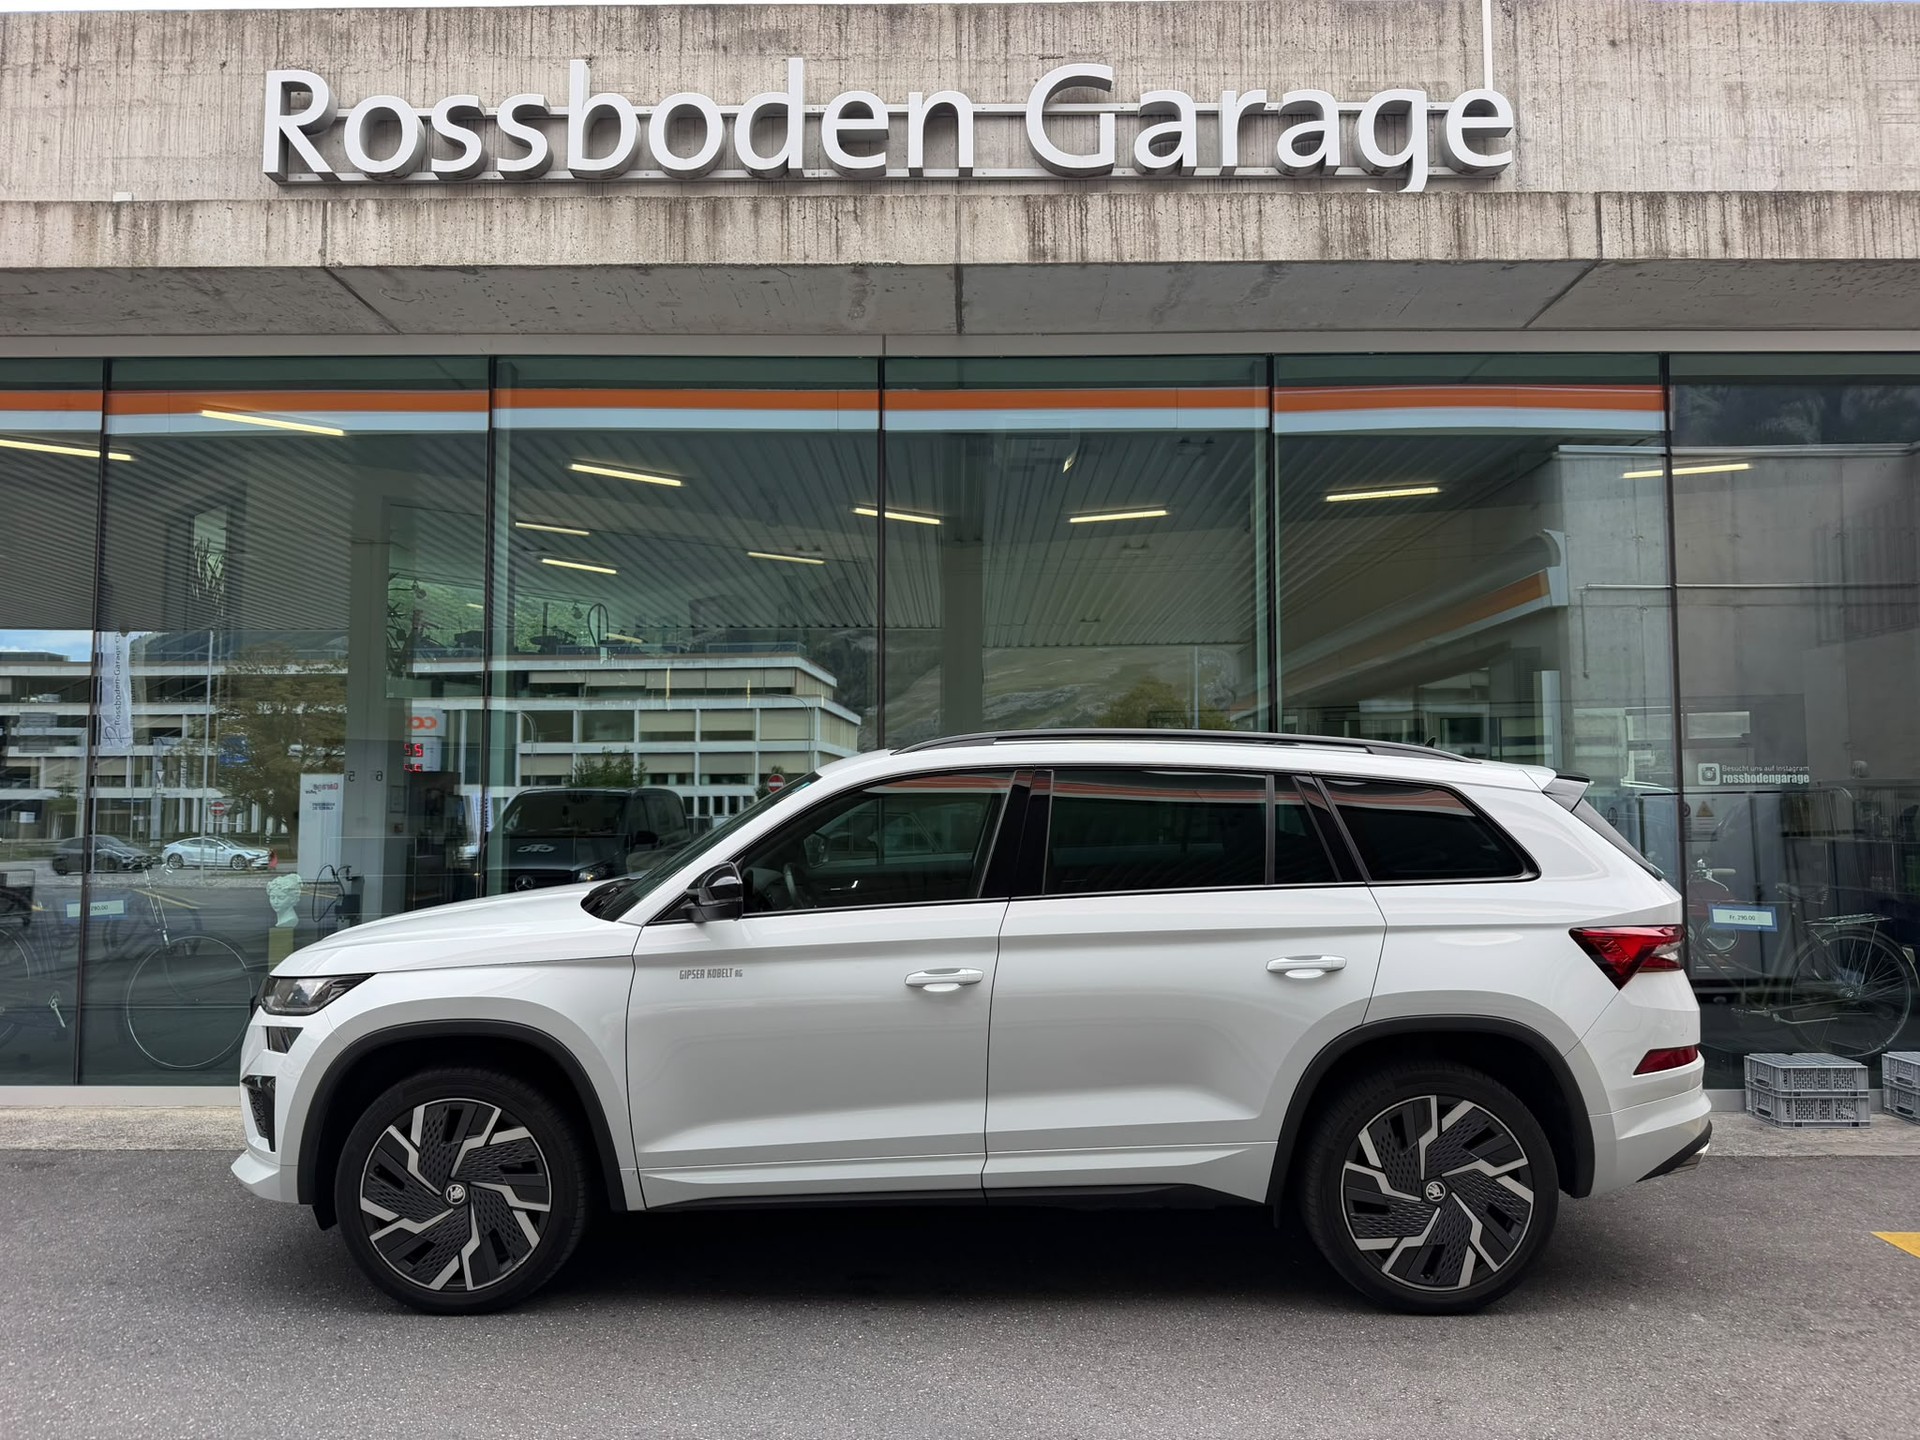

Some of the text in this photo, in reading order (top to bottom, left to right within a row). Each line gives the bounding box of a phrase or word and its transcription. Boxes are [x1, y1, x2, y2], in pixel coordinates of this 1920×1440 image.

[262, 57, 1514, 193] Rossboden Garage
[1775, 765, 1809, 774] Instagram
[1722, 773, 1810, 785] rossbodengarage
[679, 968, 705, 980] GIPSER
[706, 967, 733, 979] KOBELT
